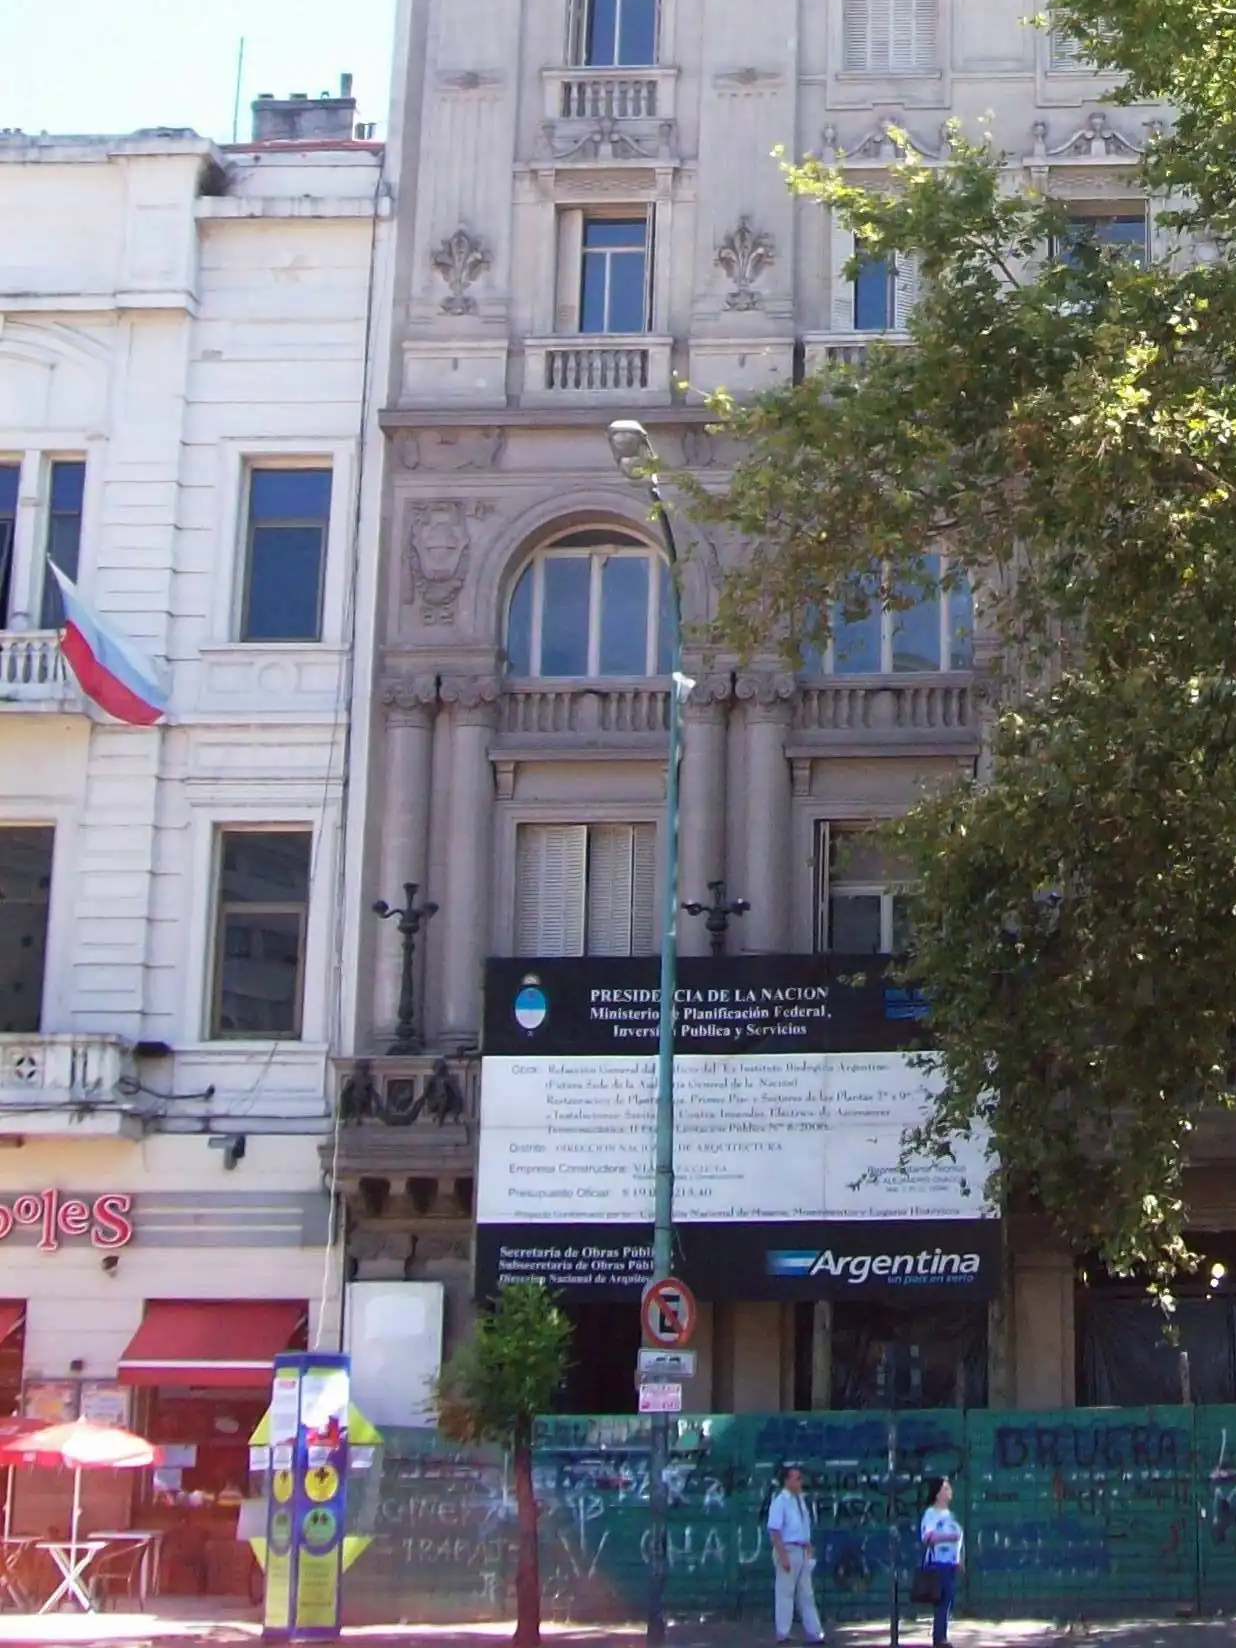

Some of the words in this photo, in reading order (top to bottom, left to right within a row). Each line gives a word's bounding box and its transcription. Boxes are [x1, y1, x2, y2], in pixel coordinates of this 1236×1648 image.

[590, 989, 704, 1003] PRESIDECIA
[708, 989, 730, 1002] DE
[734, 989, 757, 1002] LA
[761, 986, 830, 1001] NACION
[590, 1006, 660, 1020] Ministerio
[735, 1027, 741, 1040] y
[746, 1022, 808, 1036] Servicios
[564, 1246, 578, 1258] de
[581, 1246, 619, 1258] Obras
[575, 1260, 588, 1270] de
[810, 1248, 980, 1284] Argentina
